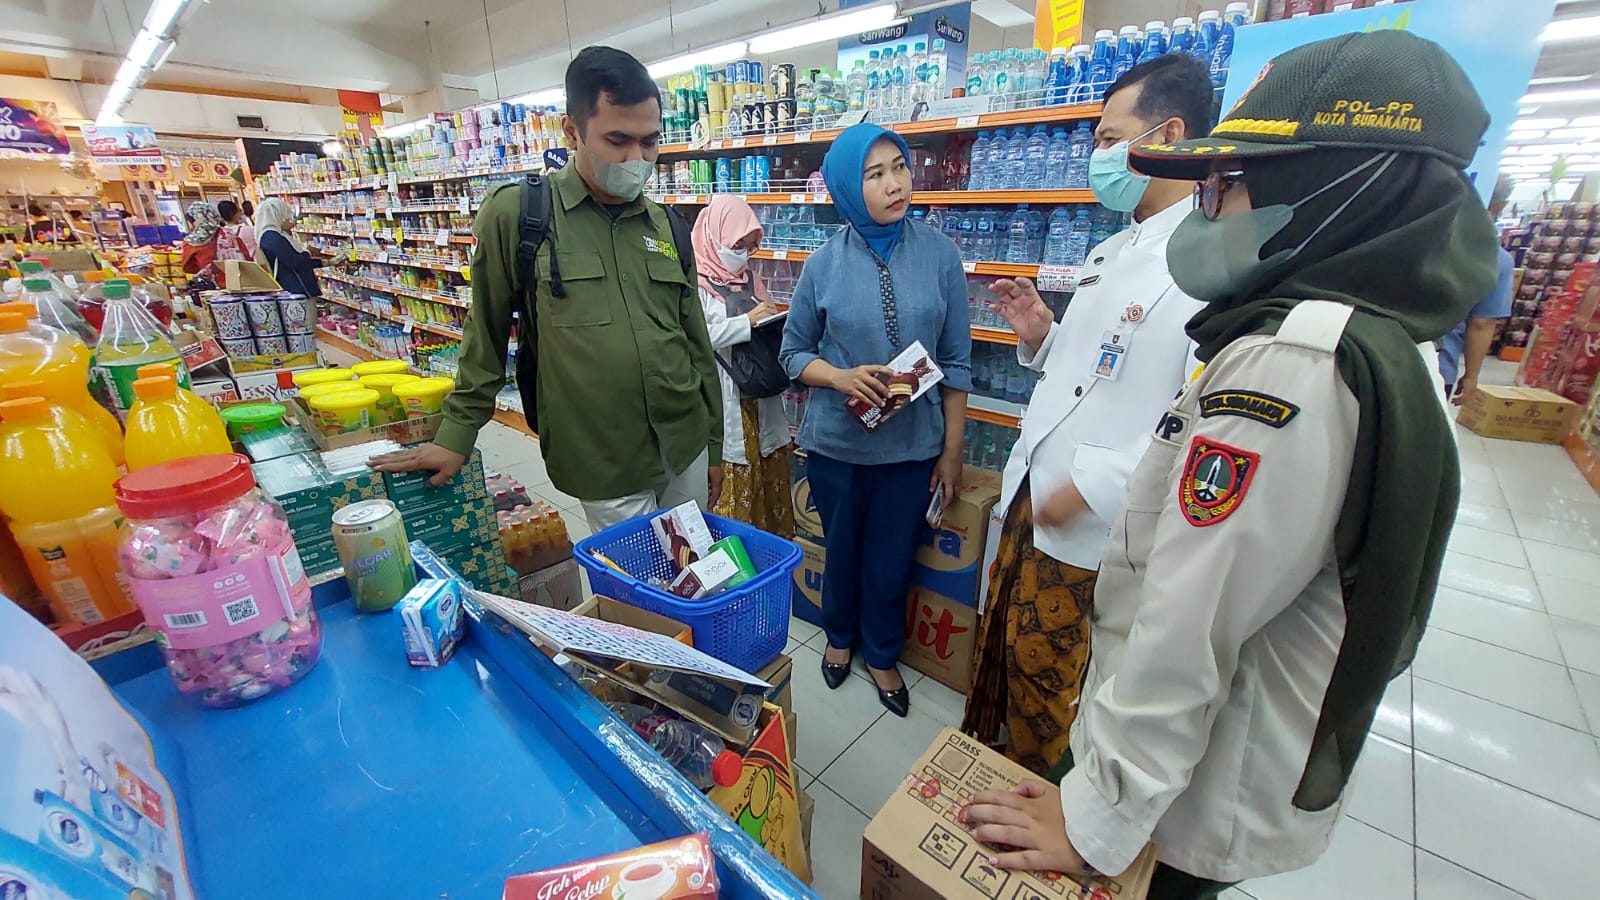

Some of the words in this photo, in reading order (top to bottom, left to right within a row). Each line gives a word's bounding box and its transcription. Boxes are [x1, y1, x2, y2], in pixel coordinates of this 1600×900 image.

[1334, 99, 1415, 116] POL-PP
[1312, 111, 1347, 127] KOTA
[1352, 113, 1423, 132] SURAKARTA
[547, 151, 567, 167] BARU
[960, 740, 982, 757] PASS
[537, 872, 570, 900] Teh
[564, 875, 611, 900] Celup
